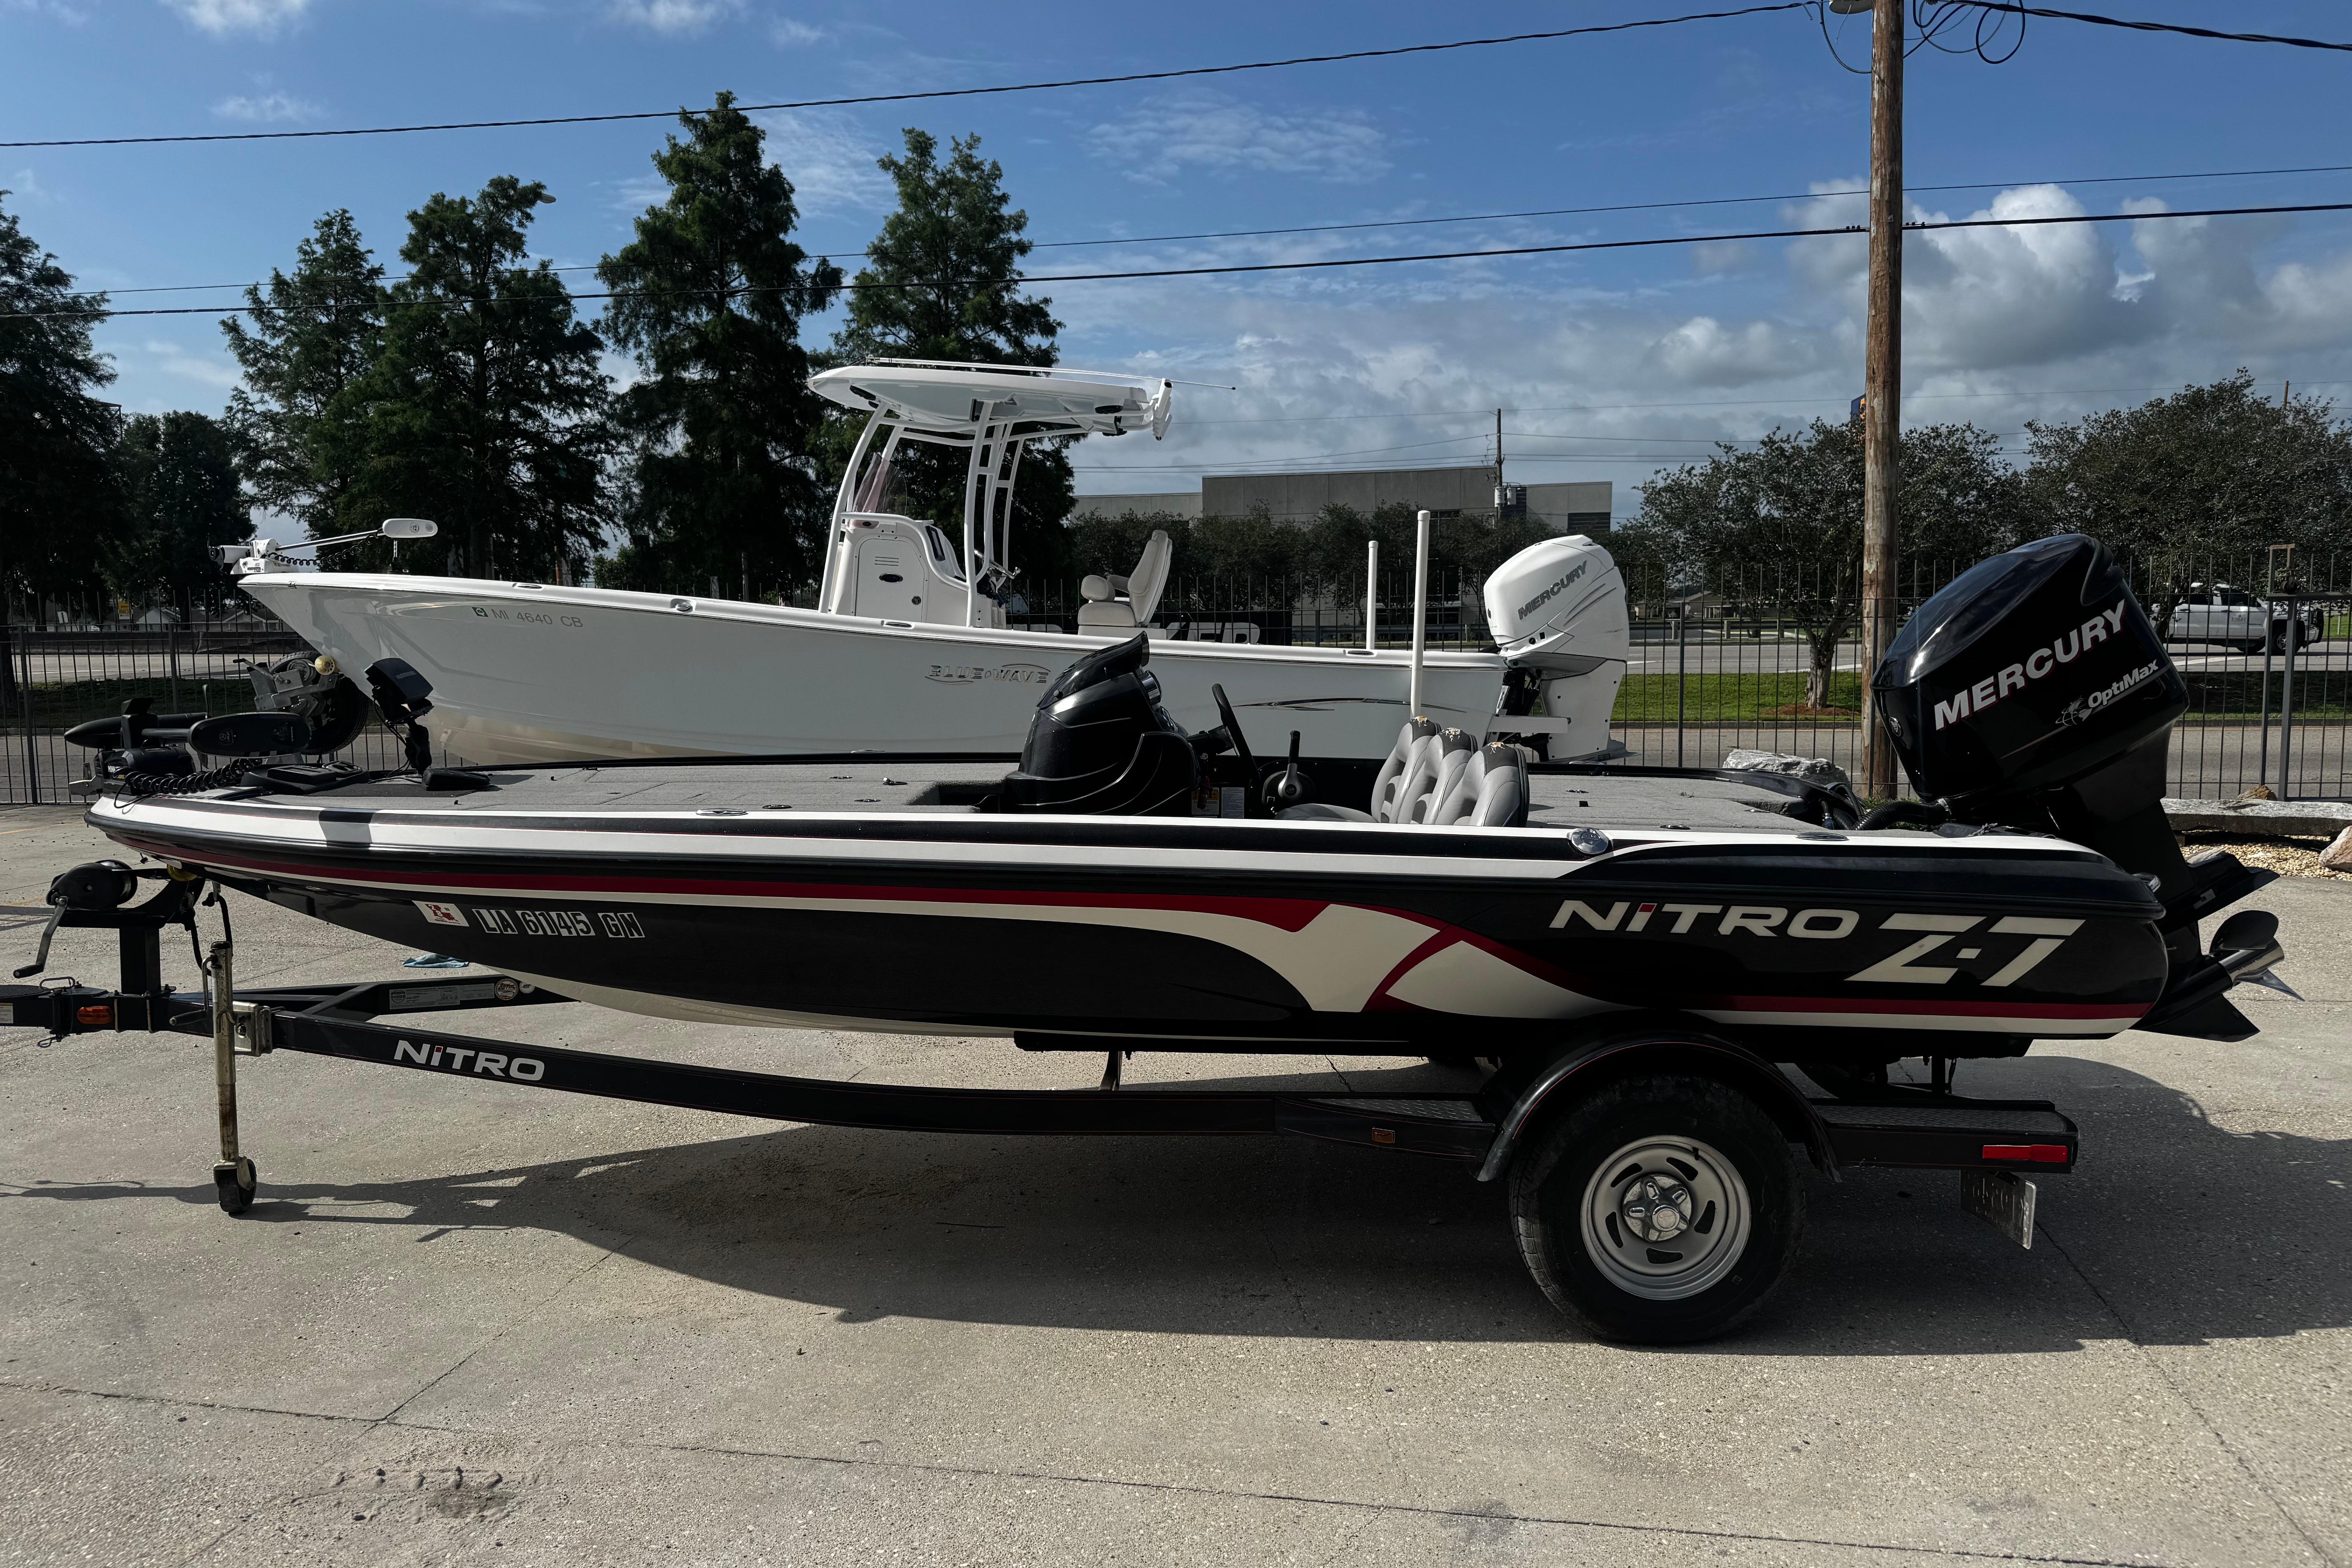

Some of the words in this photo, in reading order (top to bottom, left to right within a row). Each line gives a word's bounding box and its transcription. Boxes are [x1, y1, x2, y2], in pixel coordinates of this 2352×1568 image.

[1518, 560, 1587, 620] MERCURY
[491, 609, 509, 619] MI
[517, 612, 553, 625] 4640
[560, 616, 583, 628] CB
[929, 665, 984, 679] BLUE
[993, 669, 1049, 684] WAVE
[1934, 598, 2126, 731] MERCURY
[2088, 659, 2159, 708] OptiMax
[472, 909, 518, 934] LA
[516, 910, 596, 936] 6145
[597, 912, 645, 938] GN
